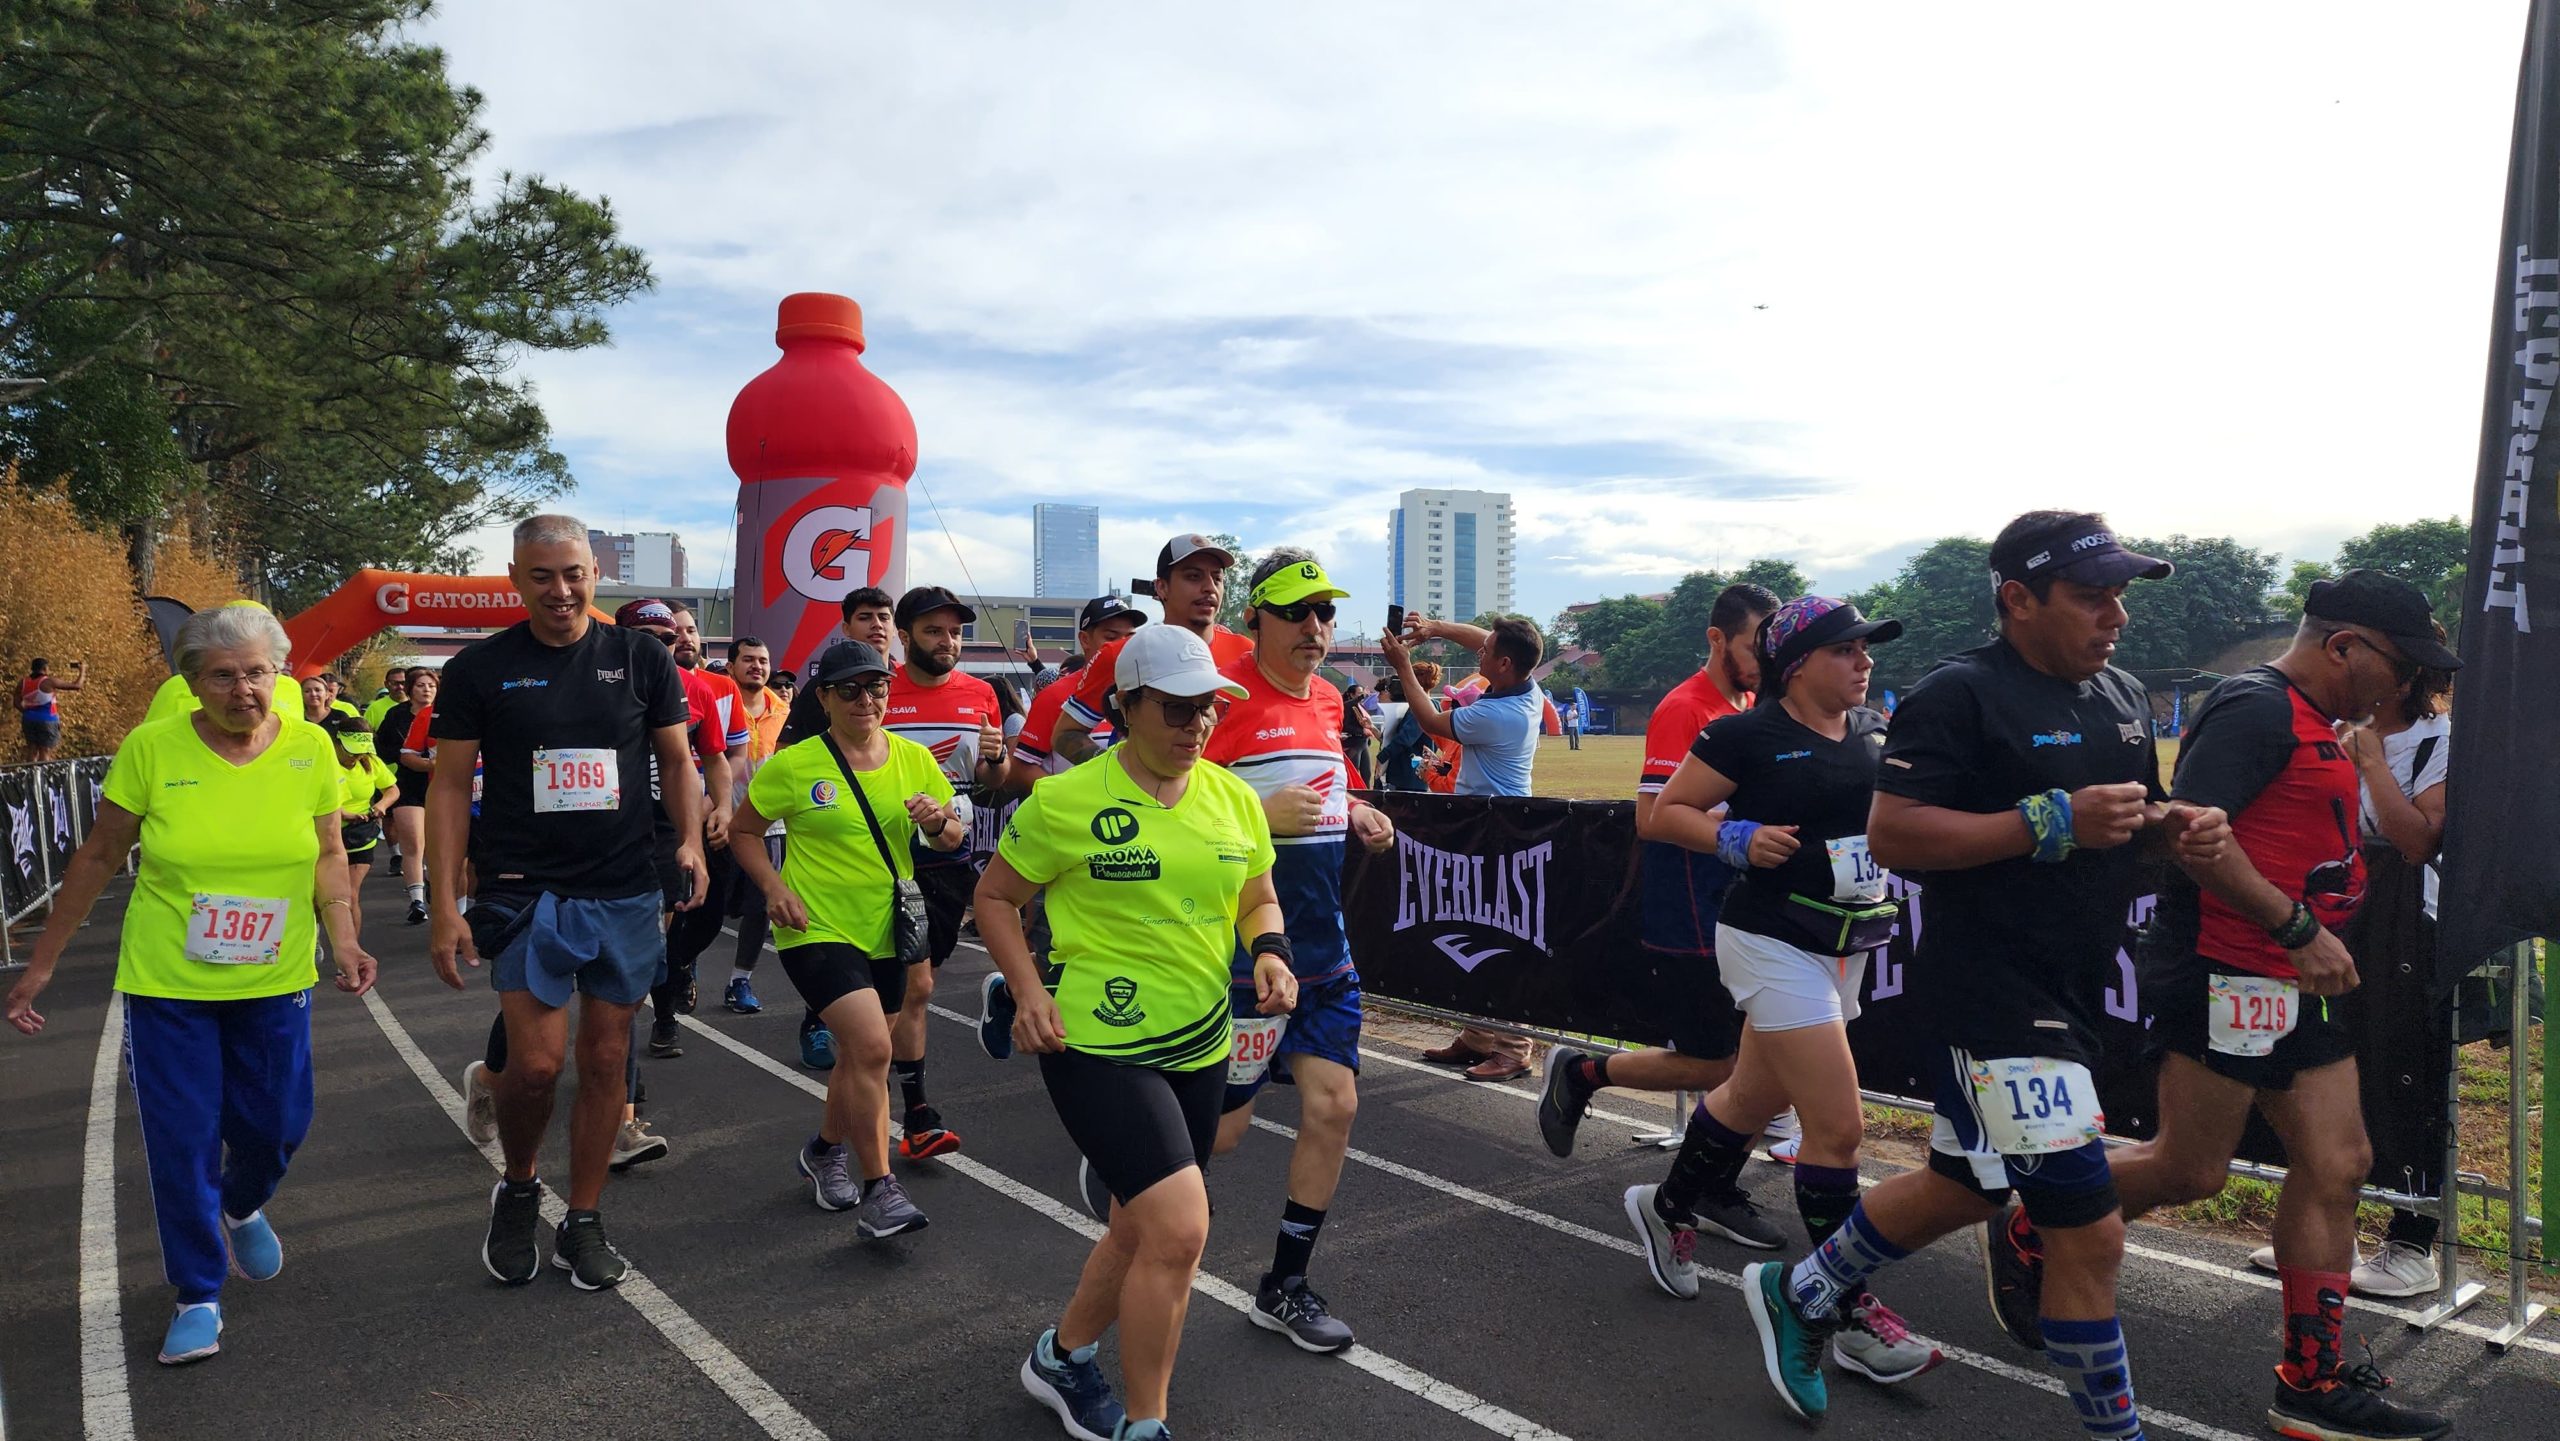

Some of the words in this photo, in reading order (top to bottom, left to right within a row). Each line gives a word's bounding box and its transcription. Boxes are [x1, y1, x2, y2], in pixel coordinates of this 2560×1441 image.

[415, 591, 527, 609] GATORAD
[597, 668, 625, 681] EVERLAST
[891, 706, 917, 714] SAVA
[1270, 727, 1296, 738] SAVA
[547, 762, 604, 790] 1369
[1393, 829, 1552, 952] EVERLAST
[203, 908, 274, 941] 1367
[2229, 995, 2286, 1031] 1219
[1229, 1028, 1277, 1062] 292
[2004, 1076, 2072, 1120] 134
